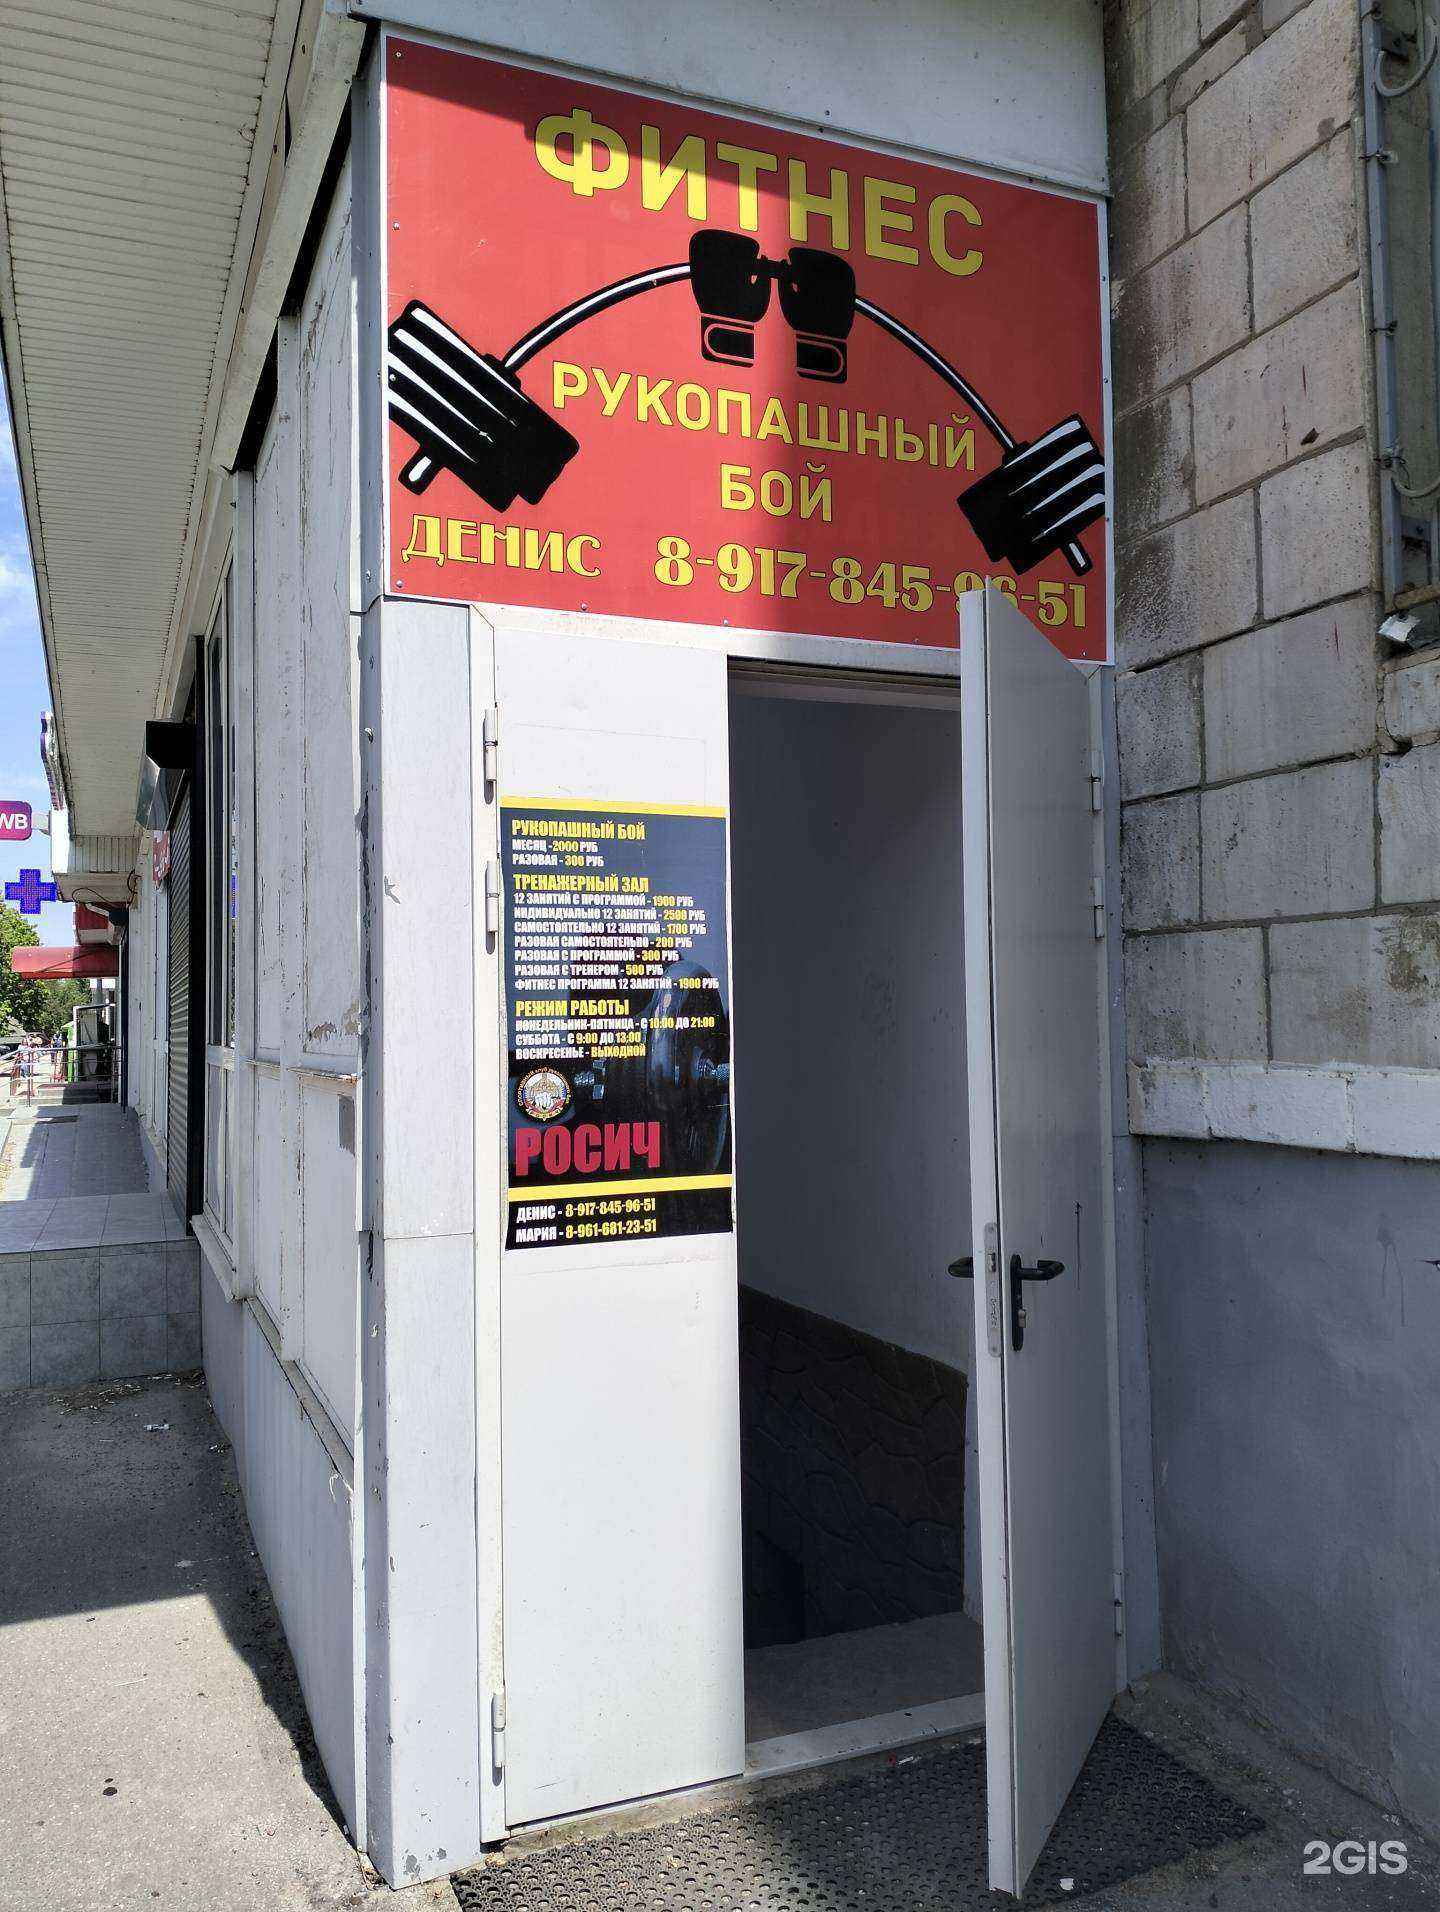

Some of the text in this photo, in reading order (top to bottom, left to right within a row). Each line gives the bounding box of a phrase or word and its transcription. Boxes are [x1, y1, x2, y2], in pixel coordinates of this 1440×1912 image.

[533, 107, 984, 277] ФИТНЕС
[551, 361, 976, 472] РУКОПАШНЫЙ
[720, 462, 833, 524] БОЙ
[401, 514, 601, 578] ДЕНИС
[512, 819, 645, 840] РУКОПАШНЫЙ БОЙ
[512, 840, 547, 852] МЕСЯЦ
[580, 842, 598, 853] РУБ
[512, 854, 558, 866] РАЗОВАЯ
[565, 856, 584, 866] 300
[586, 856, 604, 867] РУБ
[513, 873, 649, 893] ТРЕНАЖЕРНЫЙ ЗАЛ
[514, 894, 525, 904] 12
[527, 893, 571, 905] ЗАНЯТИЙ
[573, 894, 579, 905] С
[582, 894, 646, 906] ПРОГРАММОЙ
[676, 897, 693, 907] РУБ
[514, 907, 600, 920] ИНДИВИДУАЛЬНО
[602, 909, 613, 919] 12
[615, 908, 656, 920] ЗАНЯТИЙ
[688, 910, 705, 920] РУБ
[514, 922, 605, 934] САМОСТОЯТЕЛЬНО
[606, 923, 617, 933] 12
[618, 922, 660, 934] ЗАНЯТИЙ
[689, 924, 706, 934] РУБ
[515, 936, 559, 947] РАЗОВАЯ
[561, 936, 649, 948] САМОСТОЯТЕЛЬНО
[675, 937, 693, 948] РУБ
[515, 951, 559, 961] РАЗОВАЯ
[561, 950, 568, 960] С
[570, 949, 635, 961] ПРОГРАММОЙ
[662, 950, 679, 961] РУБ
[515, 965, 559, 976] РАЗОВАЯ
[561, 964, 568, 975] С
[570, 964, 619, 976] ТРЕНЕРОМ
[646, 965, 663, 975] РУБ
[515, 979, 556, 990] ФИТНЕС
[557, 979, 617, 990] ПРОГРАММА
[618, 979, 629, 989] 12
[630, 977, 672, 990] ЗАНЯТИЙ
[702, 978, 719, 989] РУБ
[515, 999, 630, 1016] РЕЖИМ РАБОТЫ
[641, 1018, 647, 1029] С
[675, 1018, 689, 1030] ДО
[691, 1017, 715, 1027] 21:00
[515, 1034, 560, 1045] СУББОТА
[567, 1033, 574, 1044] С
[599, 1033, 614, 1045] ДО
[615, 1032, 641, 1043] 13:00
[515, 1048, 584, 1059] ВОСКРЕСЕНЬЕ
[591, 1044, 646, 1059] ВЫХОДНОЙ
[515, 1121, 660, 1176] РОСИЧ
[516, 1205, 556, 1223] ДЕНИС
[565, 1198, 656, 1217] 8-917-845-96-51
[516, 1227, 556, 1243] МАРИЯ
